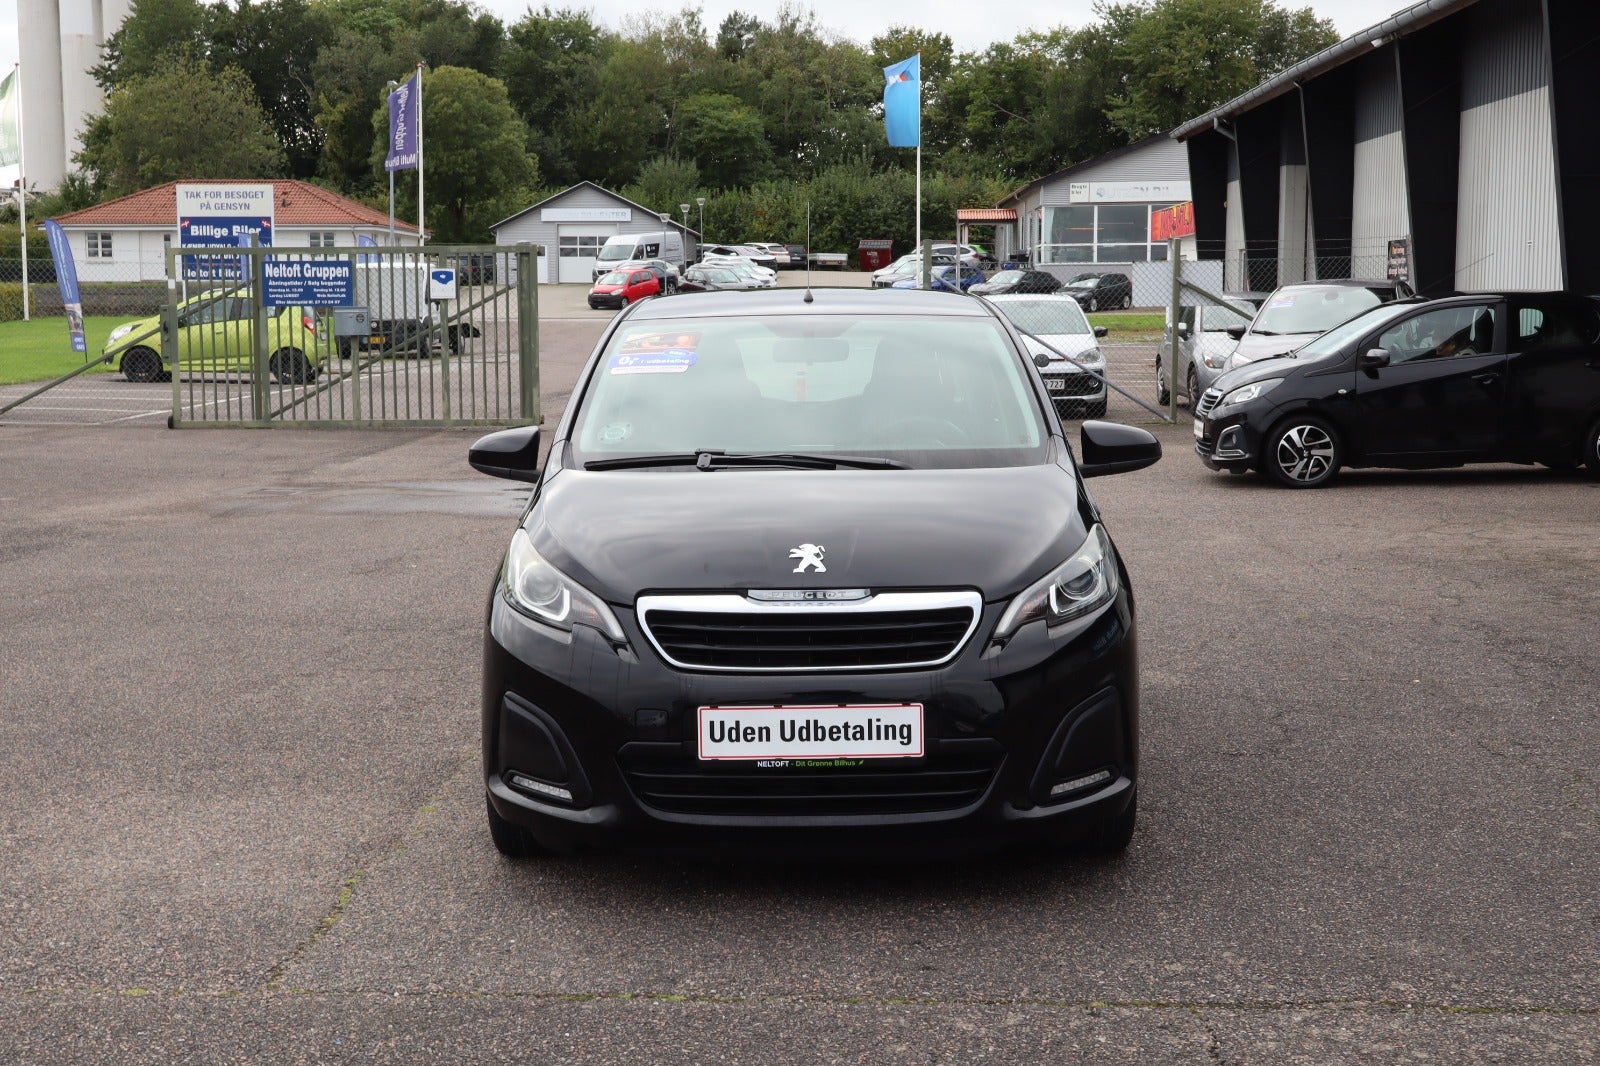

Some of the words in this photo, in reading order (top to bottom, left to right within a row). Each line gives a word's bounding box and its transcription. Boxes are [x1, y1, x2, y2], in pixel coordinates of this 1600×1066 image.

[185, 191, 201, 199] TAK
[204, 191, 222, 199] FOR
[224, 191, 264, 199] BESØGET
[200, 202, 211, 210] PÅ
[190, 225, 229, 238] Billige
[232, 225, 261, 236] Biler
[264, 263, 301, 278] Neltoft
[303, 263, 349, 280] Gruppen
[771, 591, 847, 599] PEUGEOT
[709, 720, 771, 743] Uden
[779, 718, 912, 746] Udbetaling
